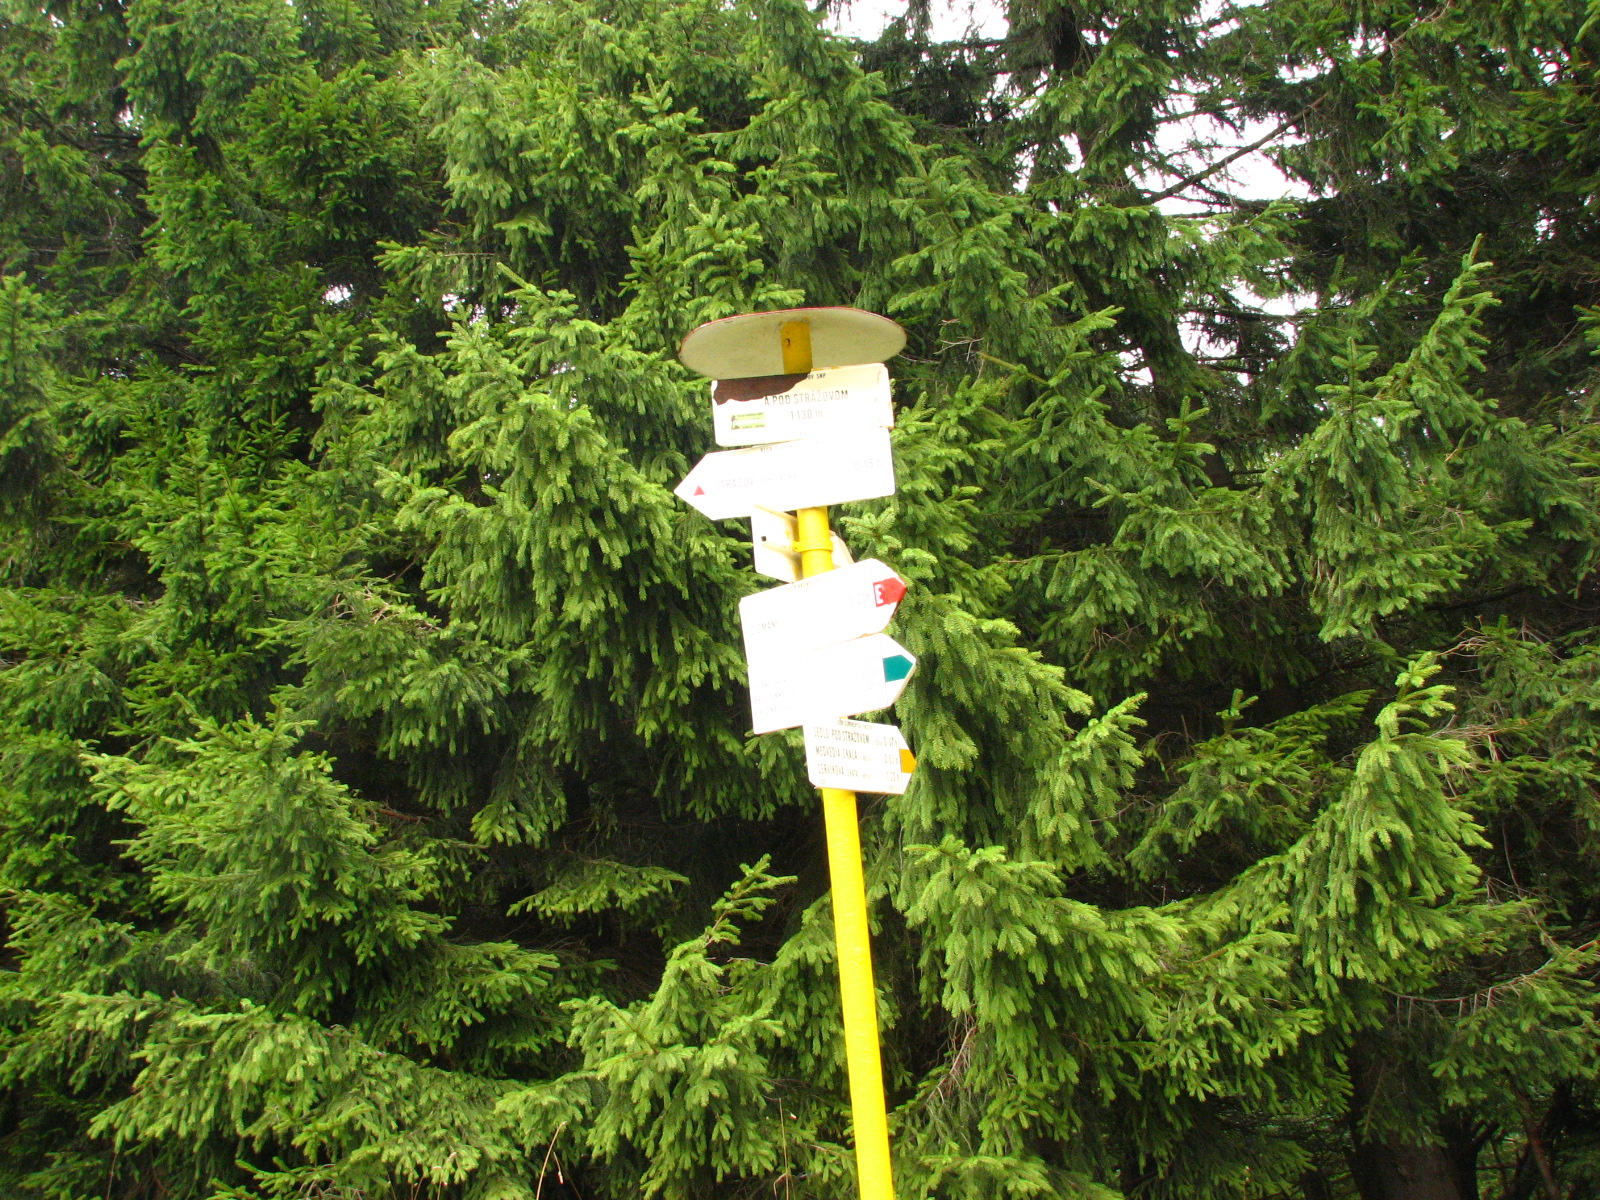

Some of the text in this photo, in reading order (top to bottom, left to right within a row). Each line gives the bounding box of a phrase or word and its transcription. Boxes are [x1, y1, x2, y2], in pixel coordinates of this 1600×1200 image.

[772, 394, 791, 406] POD
[813, 726, 829, 739] SEDLO
[831, 728, 842, 741] POD
